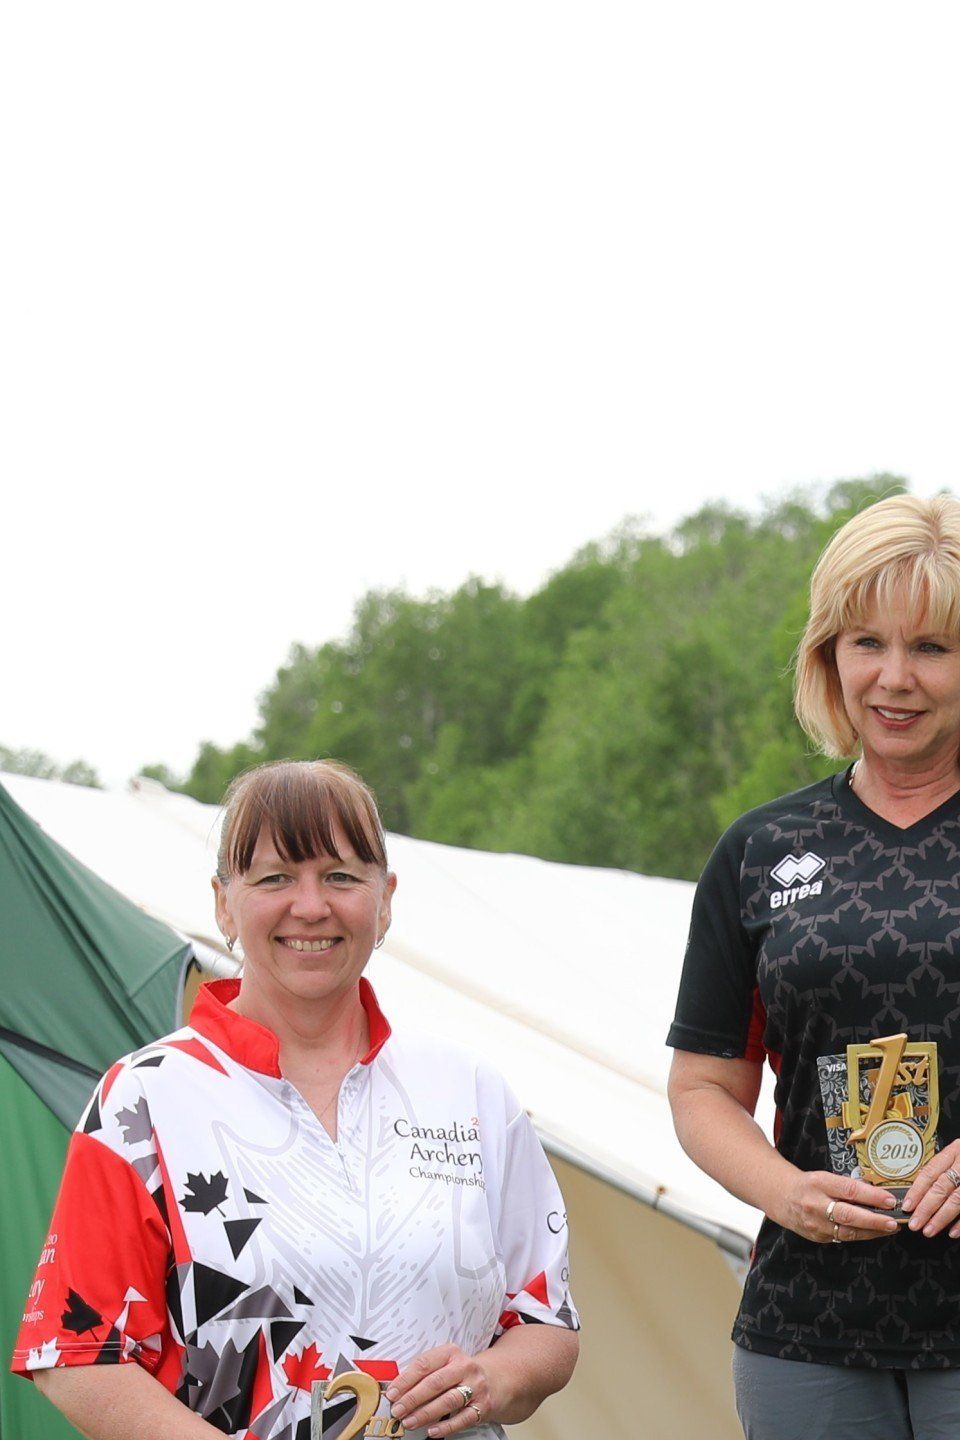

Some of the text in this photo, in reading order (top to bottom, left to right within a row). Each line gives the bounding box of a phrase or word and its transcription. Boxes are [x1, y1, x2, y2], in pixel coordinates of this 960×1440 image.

[826, 1062, 847, 1073] VISA
[393, 1119, 481, 1142] Canadia
[880, 1143, 919, 1160] 2019
